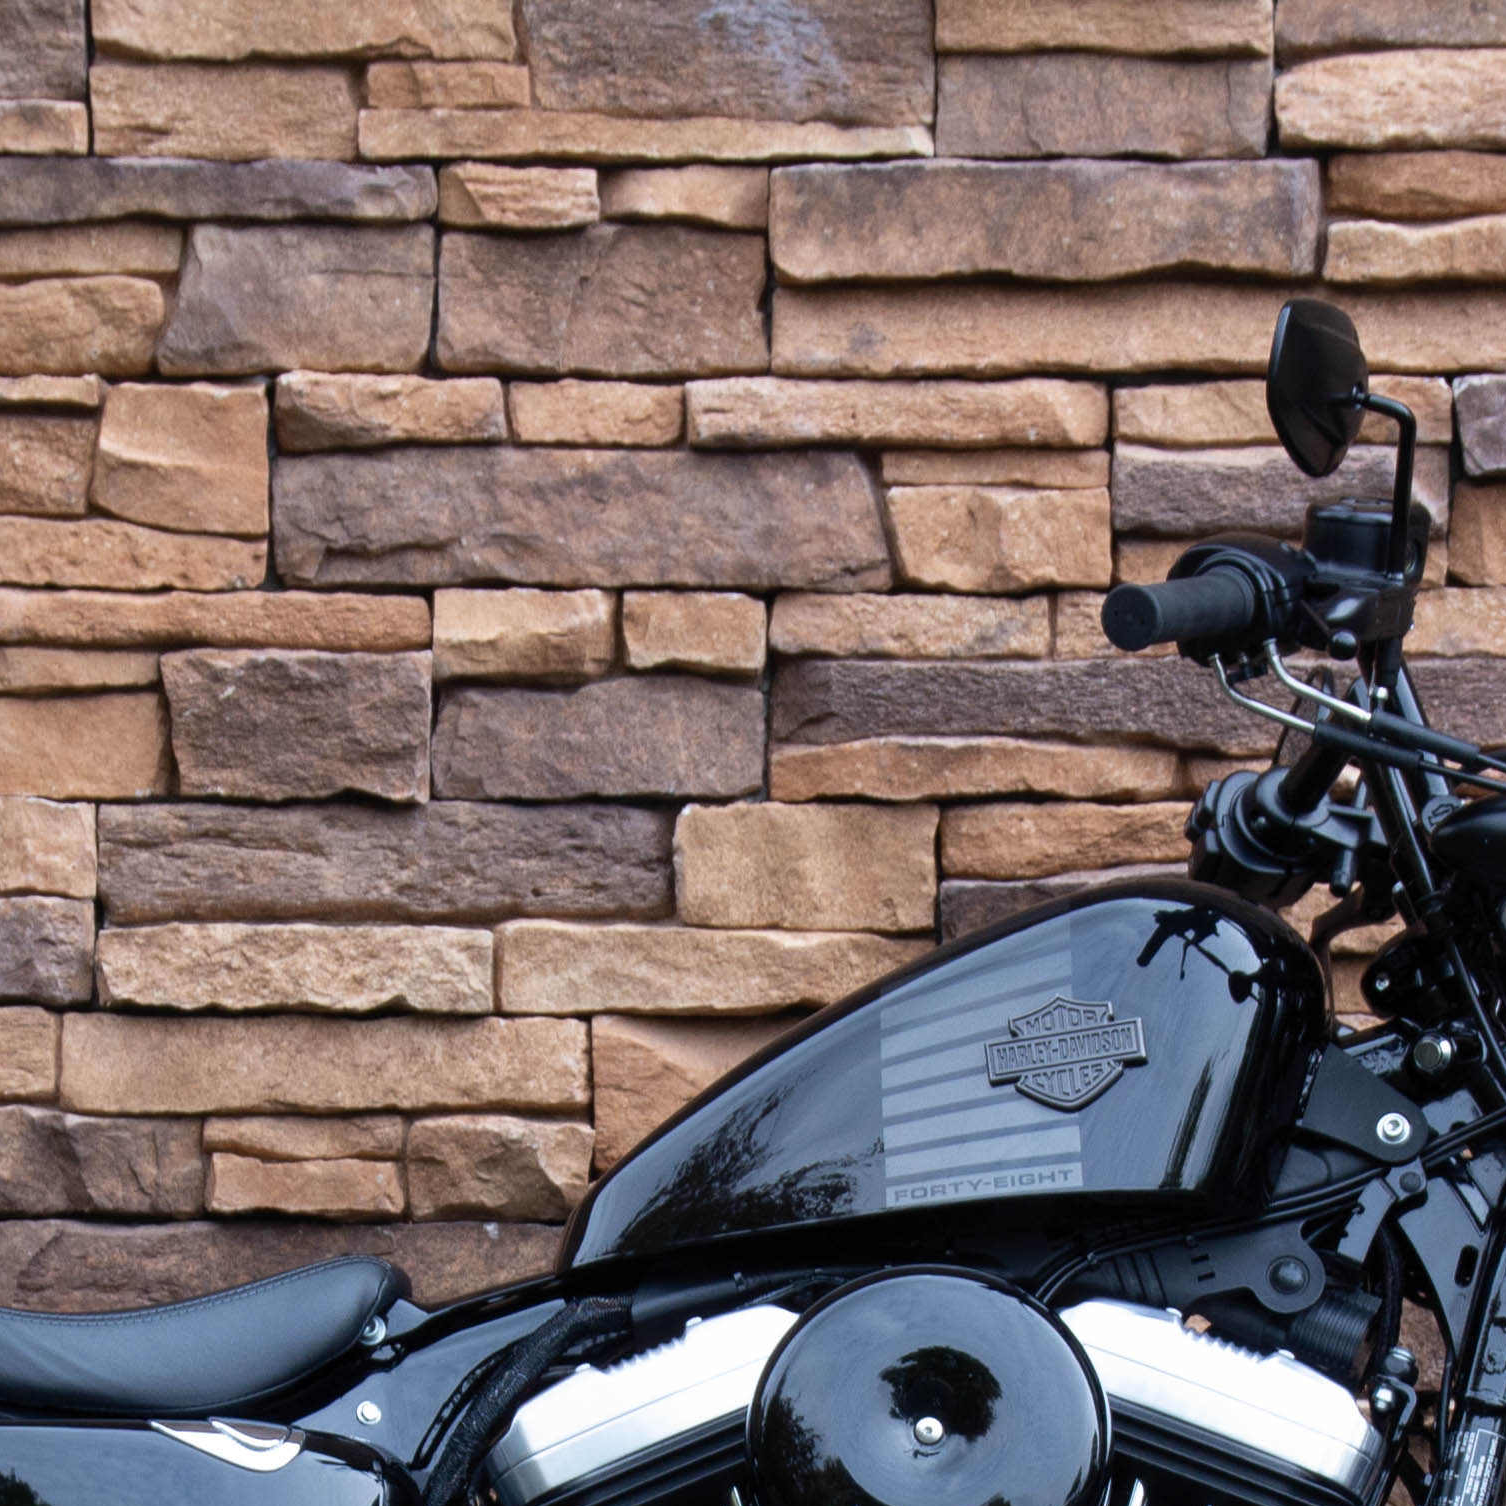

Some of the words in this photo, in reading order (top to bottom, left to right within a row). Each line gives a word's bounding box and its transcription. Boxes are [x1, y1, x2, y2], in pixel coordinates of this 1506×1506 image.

[996, 1027, 1132, 1071] HARLEY-DAVIDSON
[1026, 1062, 1104, 1097] CYCLES
[895, 1169, 1073, 1202] FORTY-EIGHT
